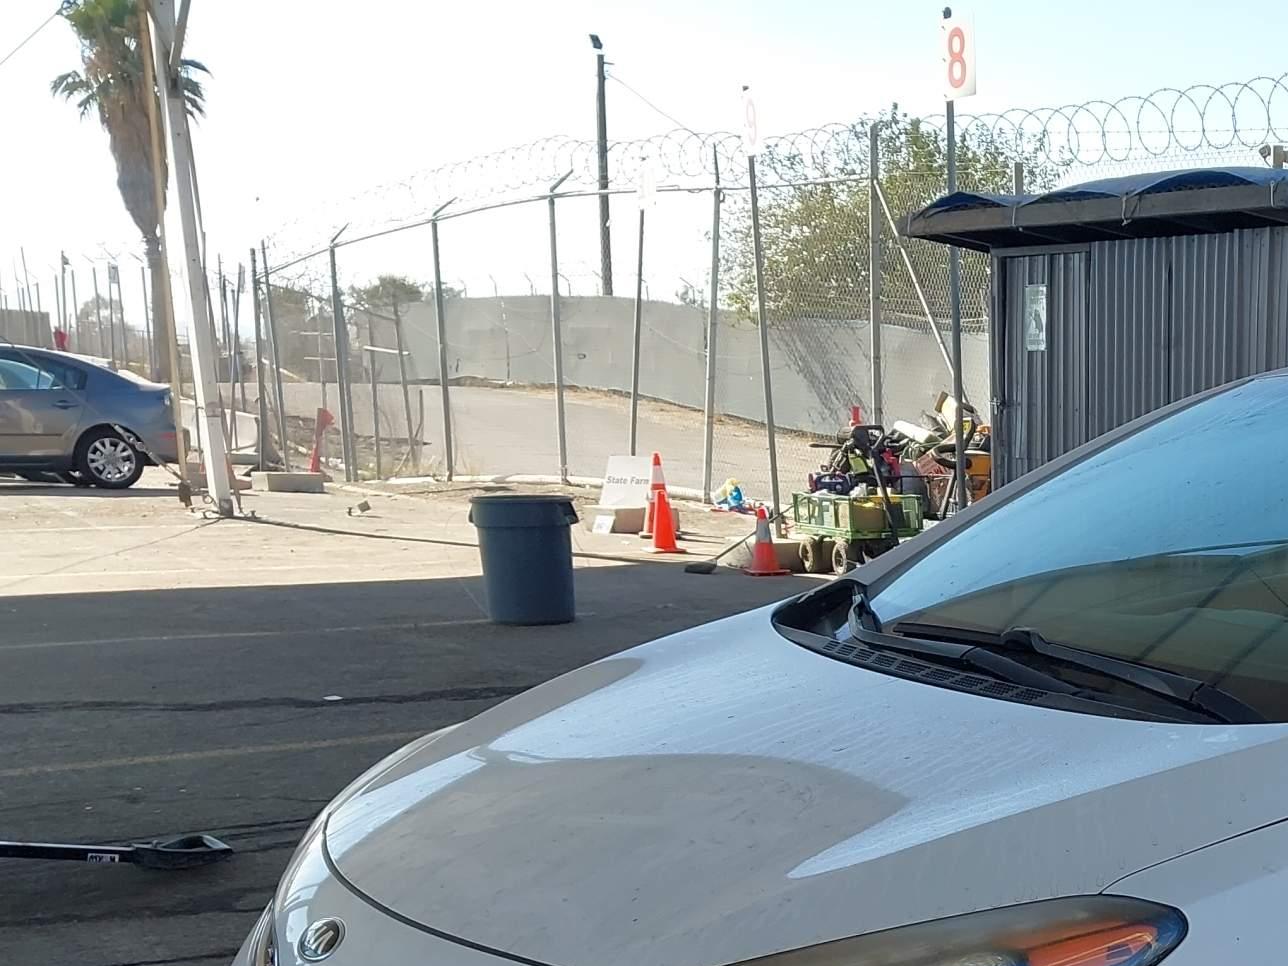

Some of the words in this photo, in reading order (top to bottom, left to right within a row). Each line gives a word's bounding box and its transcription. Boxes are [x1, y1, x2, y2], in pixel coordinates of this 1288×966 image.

[947, 26, 967, 89] 8
[746, 98, 757, 146] 9
[606, 475, 628, 485] State
[630, 476, 650, 485] Farm
